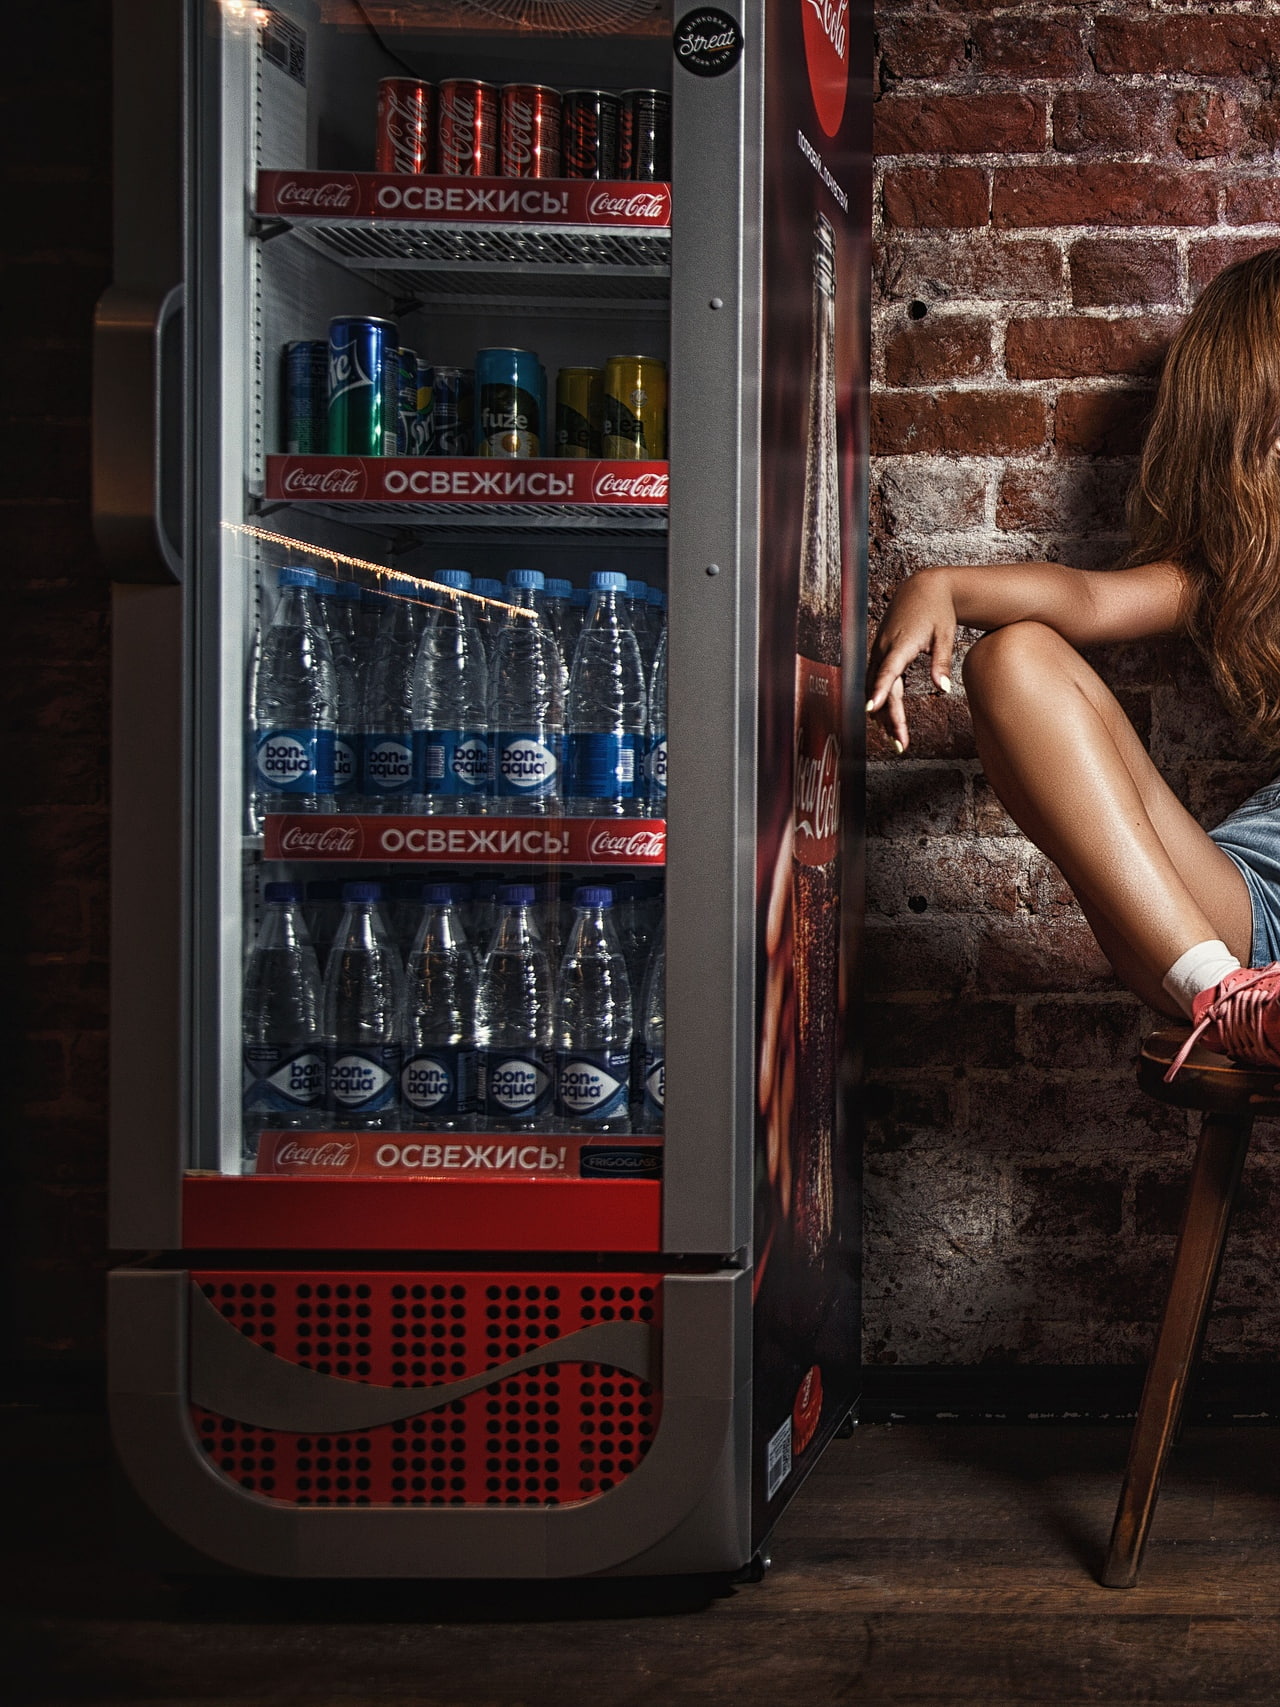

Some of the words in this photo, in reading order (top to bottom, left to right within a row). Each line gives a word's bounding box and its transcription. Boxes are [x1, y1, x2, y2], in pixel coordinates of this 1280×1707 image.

[680, 27, 736, 55] Streat
[277, 181, 355, 207] Coca-Cola
[377, 186, 569, 214] ОСВЕЖИСЬ!
[590, 192, 666, 217] Coca-Cola
[480, 407, 528, 430] fuze
[285, 467, 362, 493] Coca-Cola
[384, 470, 575, 496] ОСВЕЖИСЬ!
[595, 473, 669, 498] Coca-Cola
[282, 826, 358, 851] Coca-Cola
[381, 828, 570, 854] ОСВЕЖИСЬ!
[591, 830, 666, 857] Coca-Cola
[277, 1141, 355, 1166] Coca-Cola
[376, 1144, 567, 1169] ОСВЕЖИСЬ!
[589, 1157, 657, 1167] FRIGOGLASS
